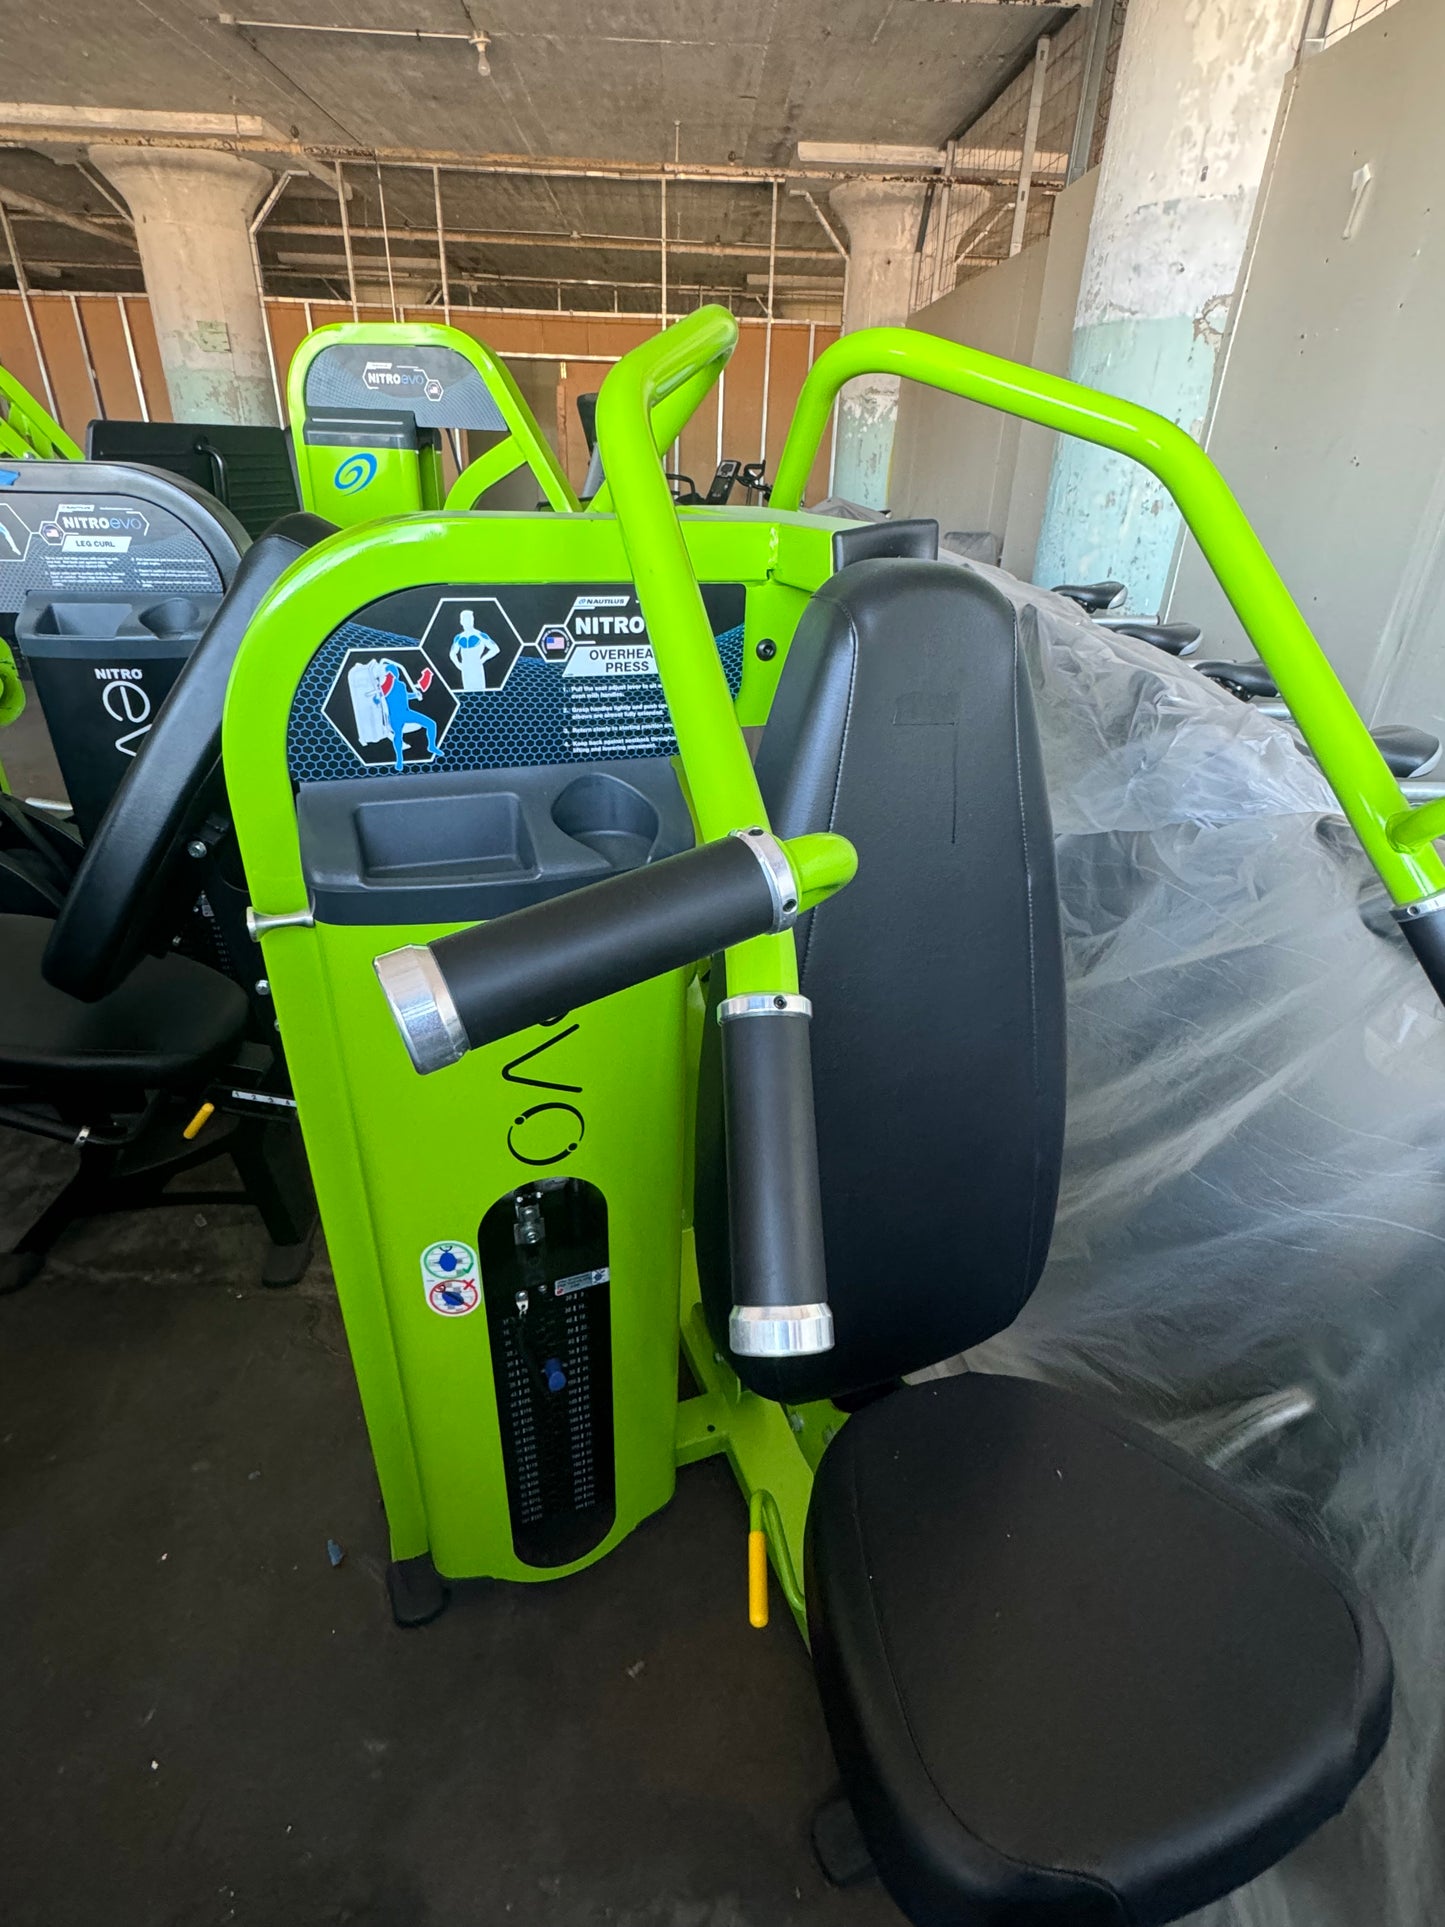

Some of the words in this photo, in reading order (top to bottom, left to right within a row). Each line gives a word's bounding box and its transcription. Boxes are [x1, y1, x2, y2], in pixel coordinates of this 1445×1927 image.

[93, 540, 116, 548] CURL
[589, 649, 654, 661] OVERHEA
[605, 661, 650, 673] PRESS
[94, 668, 143, 681] NITRO
